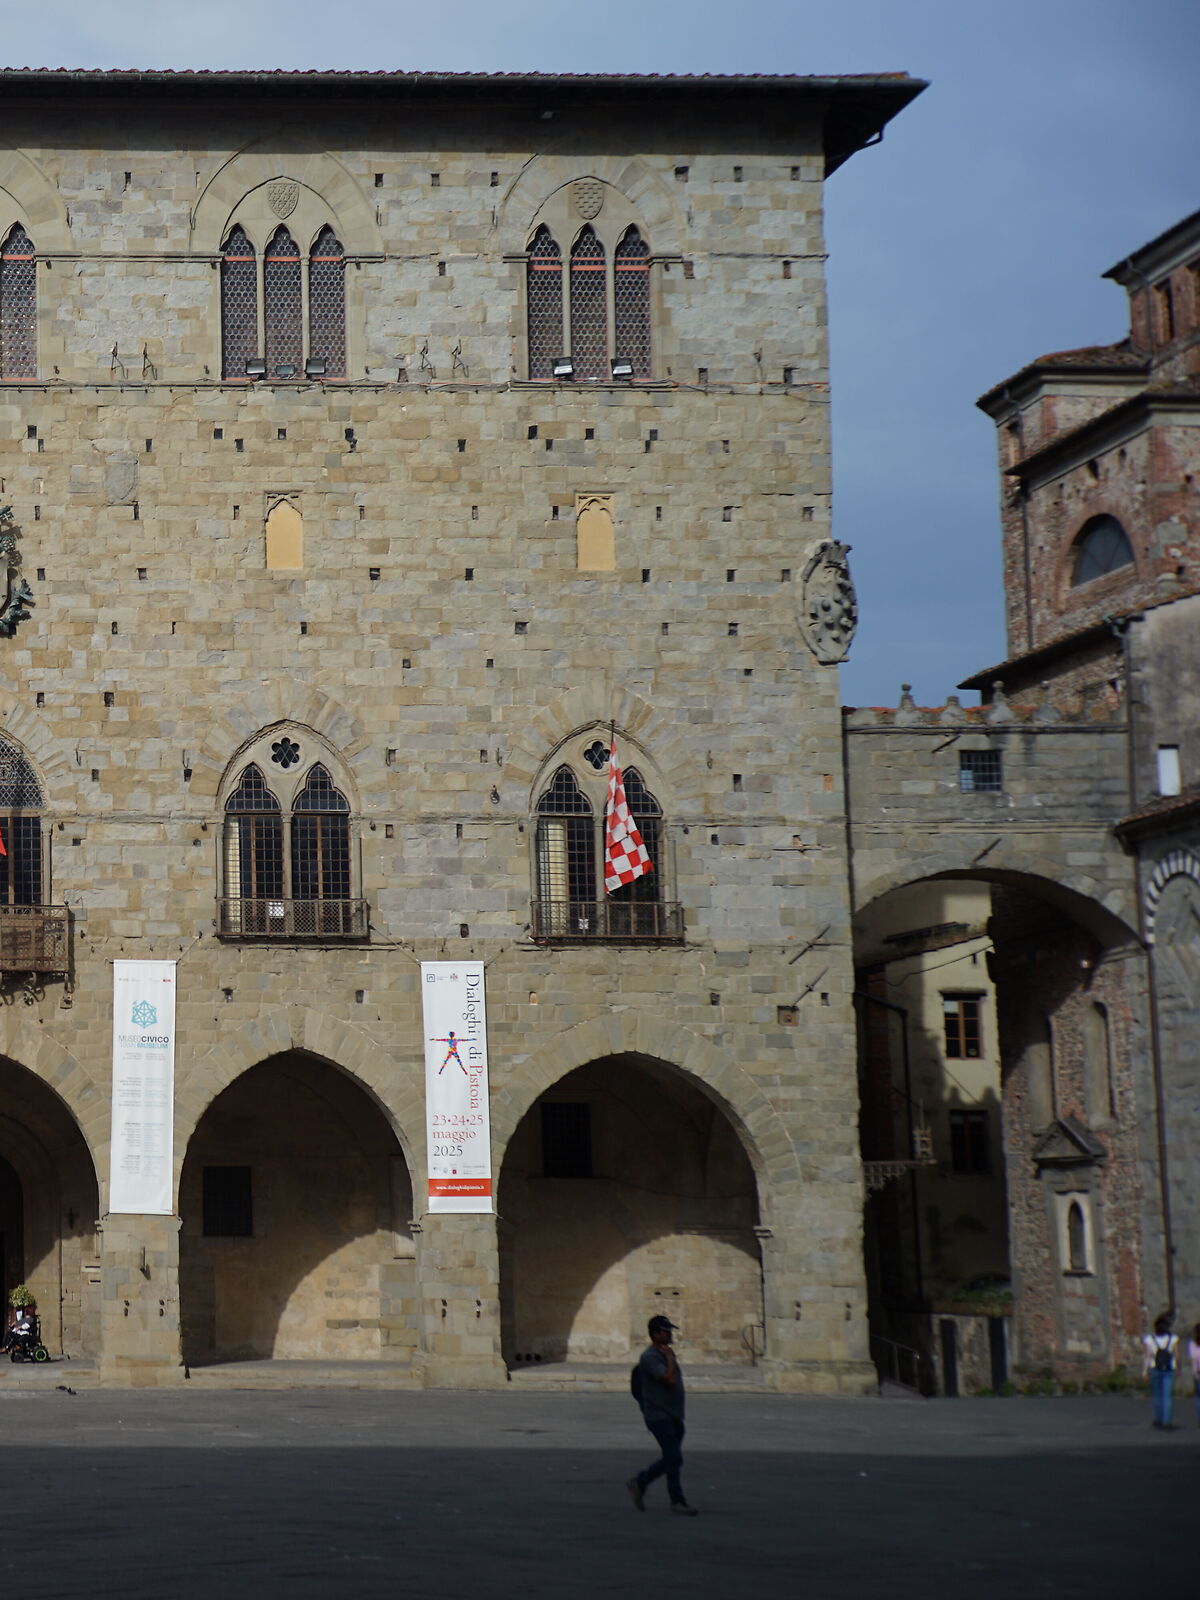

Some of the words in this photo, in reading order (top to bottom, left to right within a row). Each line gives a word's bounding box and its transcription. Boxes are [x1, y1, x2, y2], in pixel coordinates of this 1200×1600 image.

[462, 974, 481, 1033] Dialoghi
[469, 1046, 482, 1059] di
[470, 1065, 483, 1109] Pistoia
[432, 1128, 476, 1143] maggio
[433, 1145, 463, 1156] 2025
